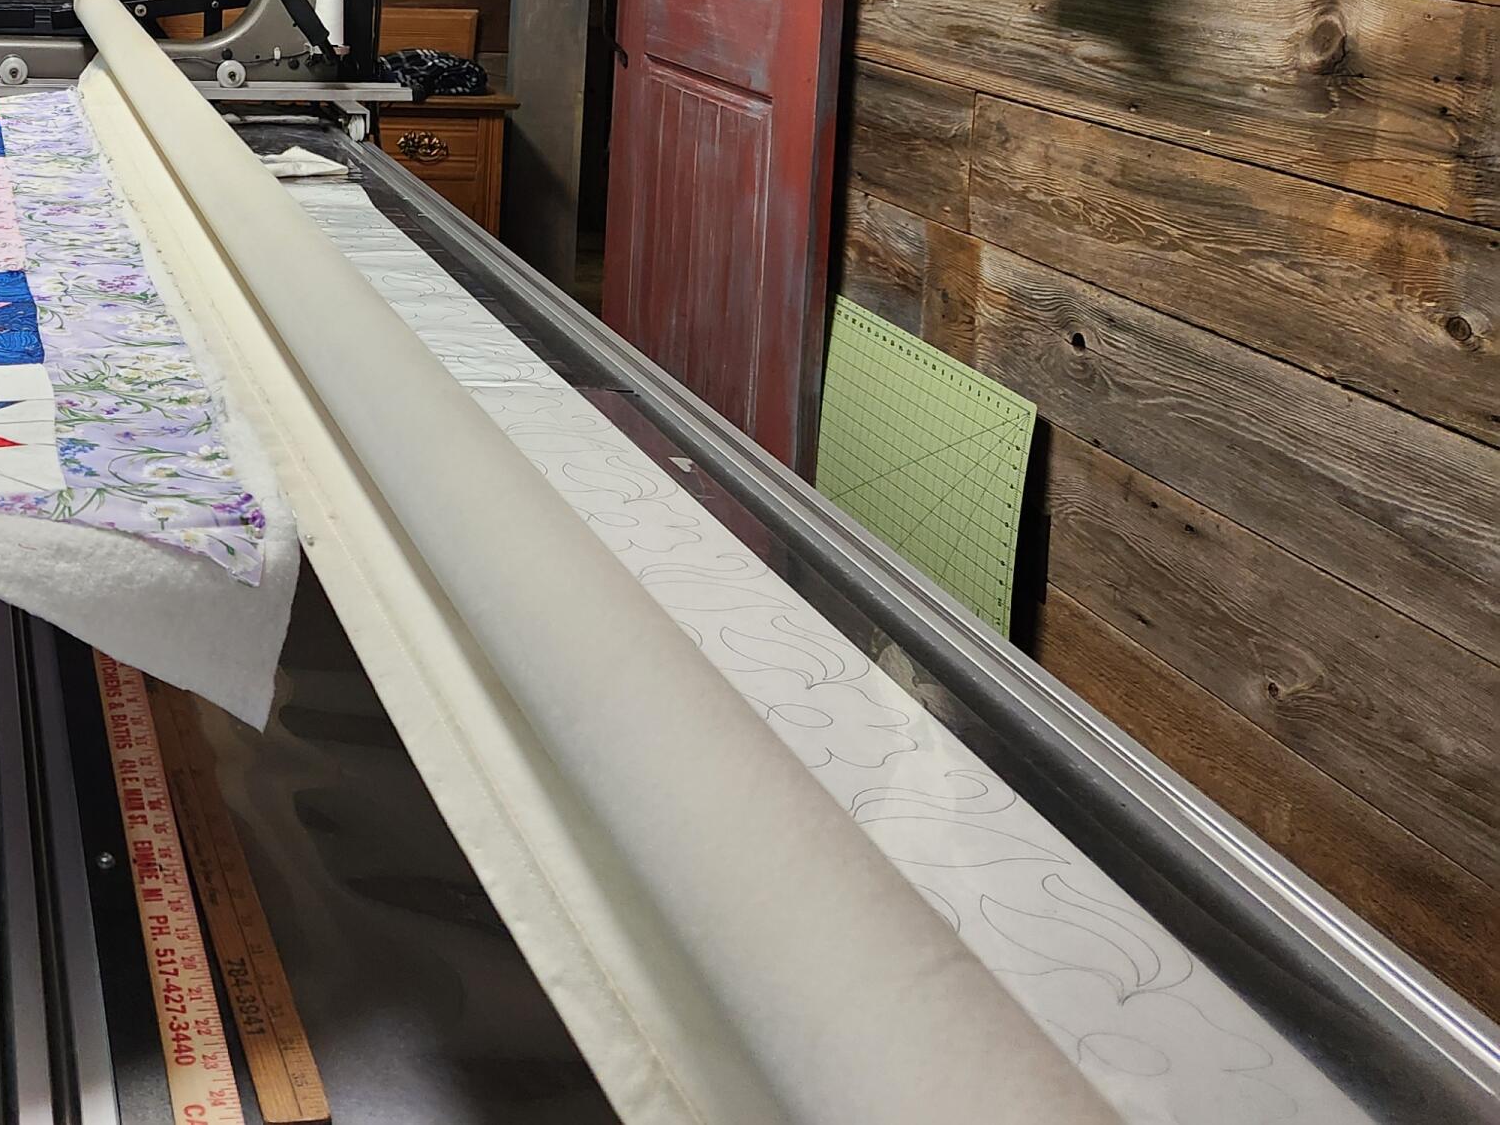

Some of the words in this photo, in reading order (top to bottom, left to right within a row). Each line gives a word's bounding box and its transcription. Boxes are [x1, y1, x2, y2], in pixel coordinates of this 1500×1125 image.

[99, 654, 122, 698] ITCHENS
[111, 714, 133, 750] BATHS
[148, 915, 171, 941] PH.
[155, 947, 197, 1067] 517-427-3440
